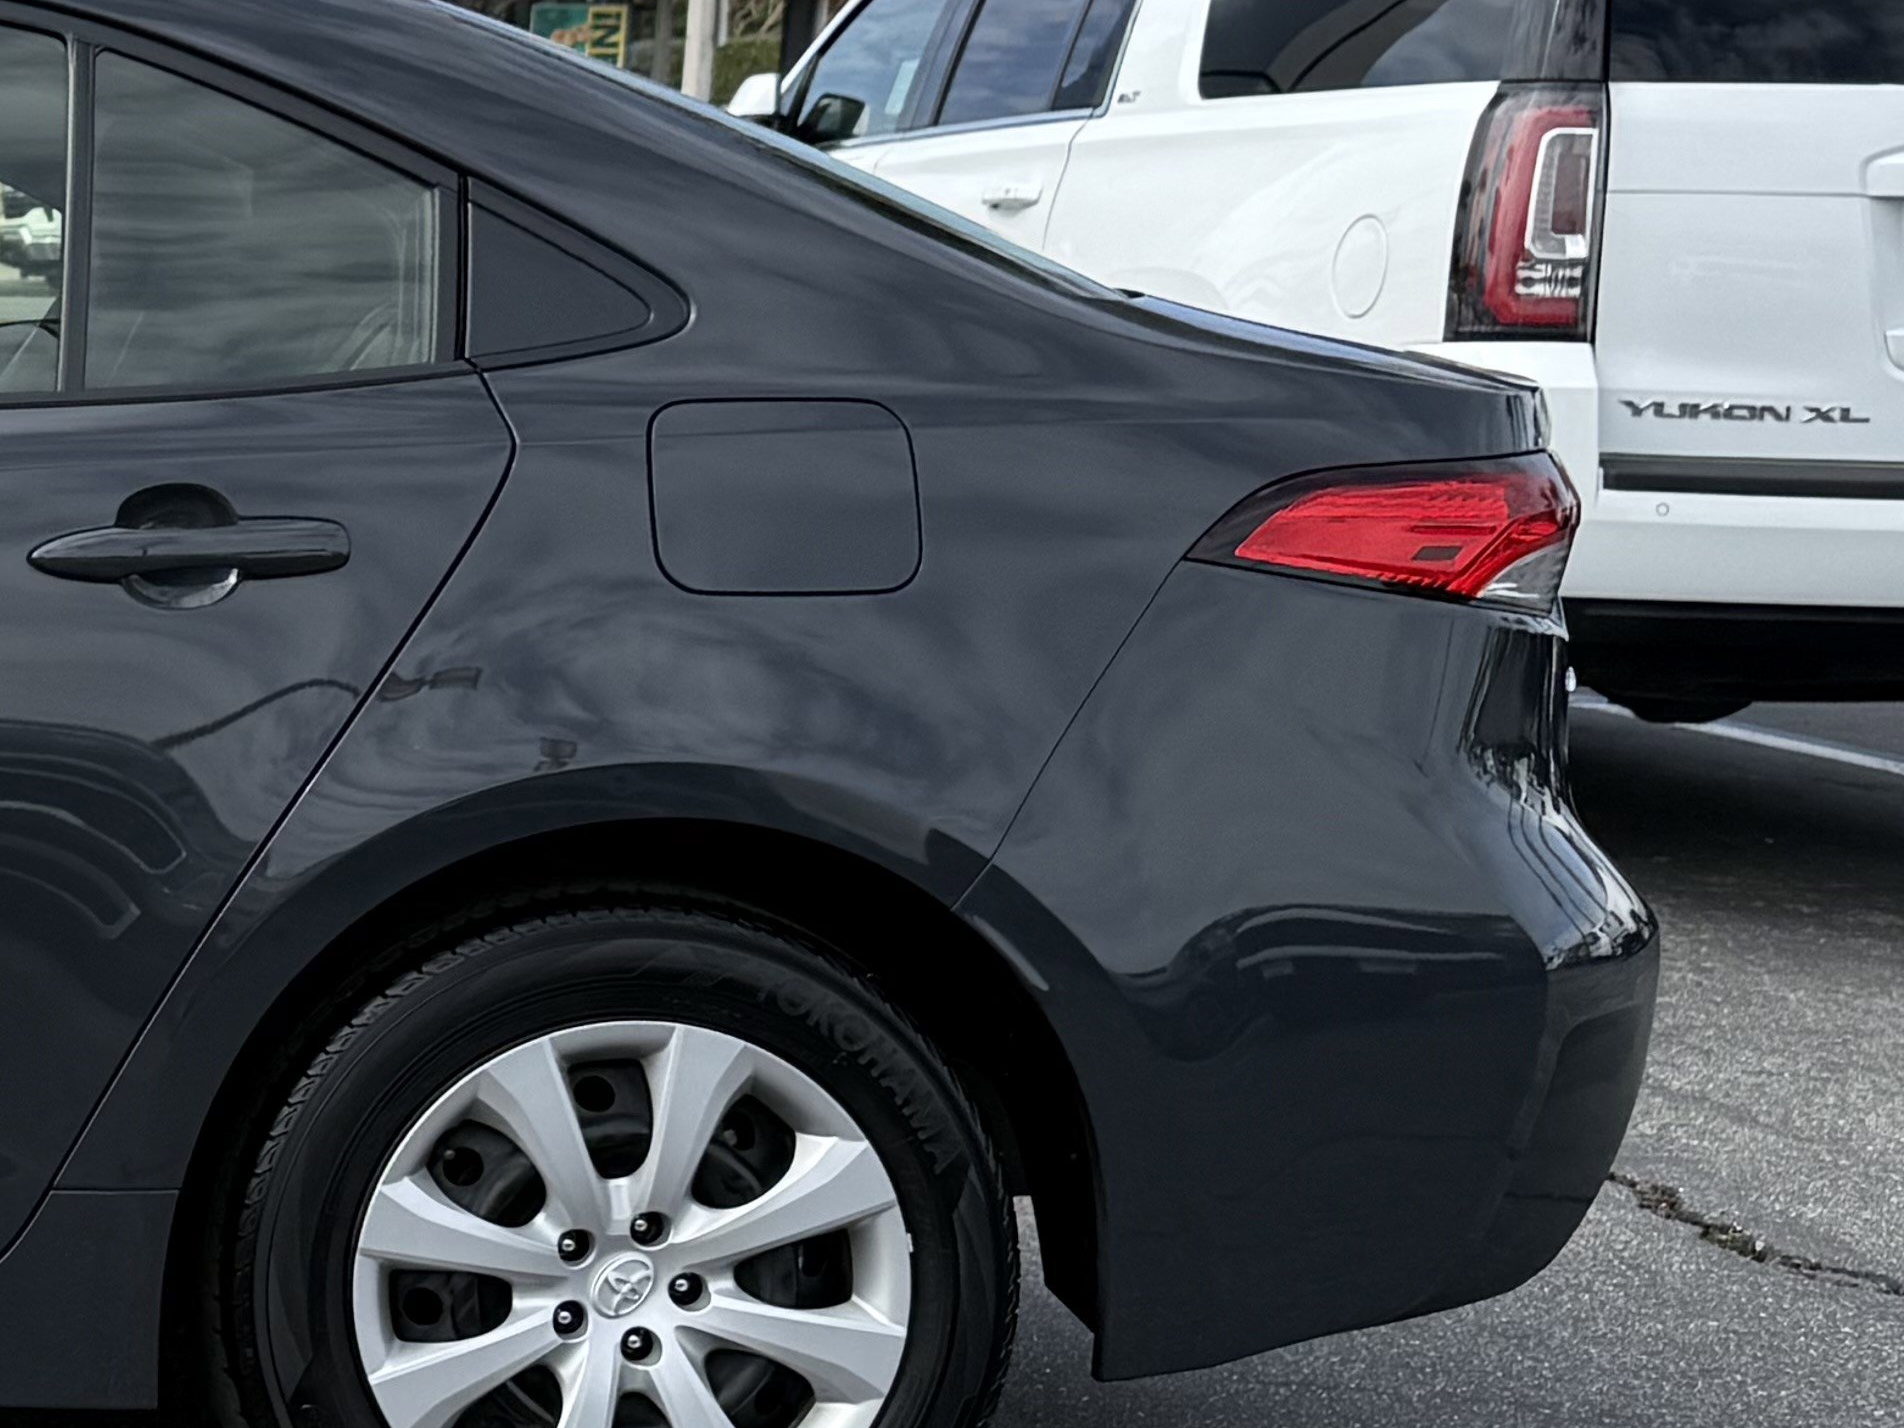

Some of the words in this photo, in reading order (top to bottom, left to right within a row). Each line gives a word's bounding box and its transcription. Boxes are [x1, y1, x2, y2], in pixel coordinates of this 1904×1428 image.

[1618, 400, 1791, 422] YUKON
[1800, 405, 1871, 424] XL
[755, 972, 964, 1175] YOKOHAMA
